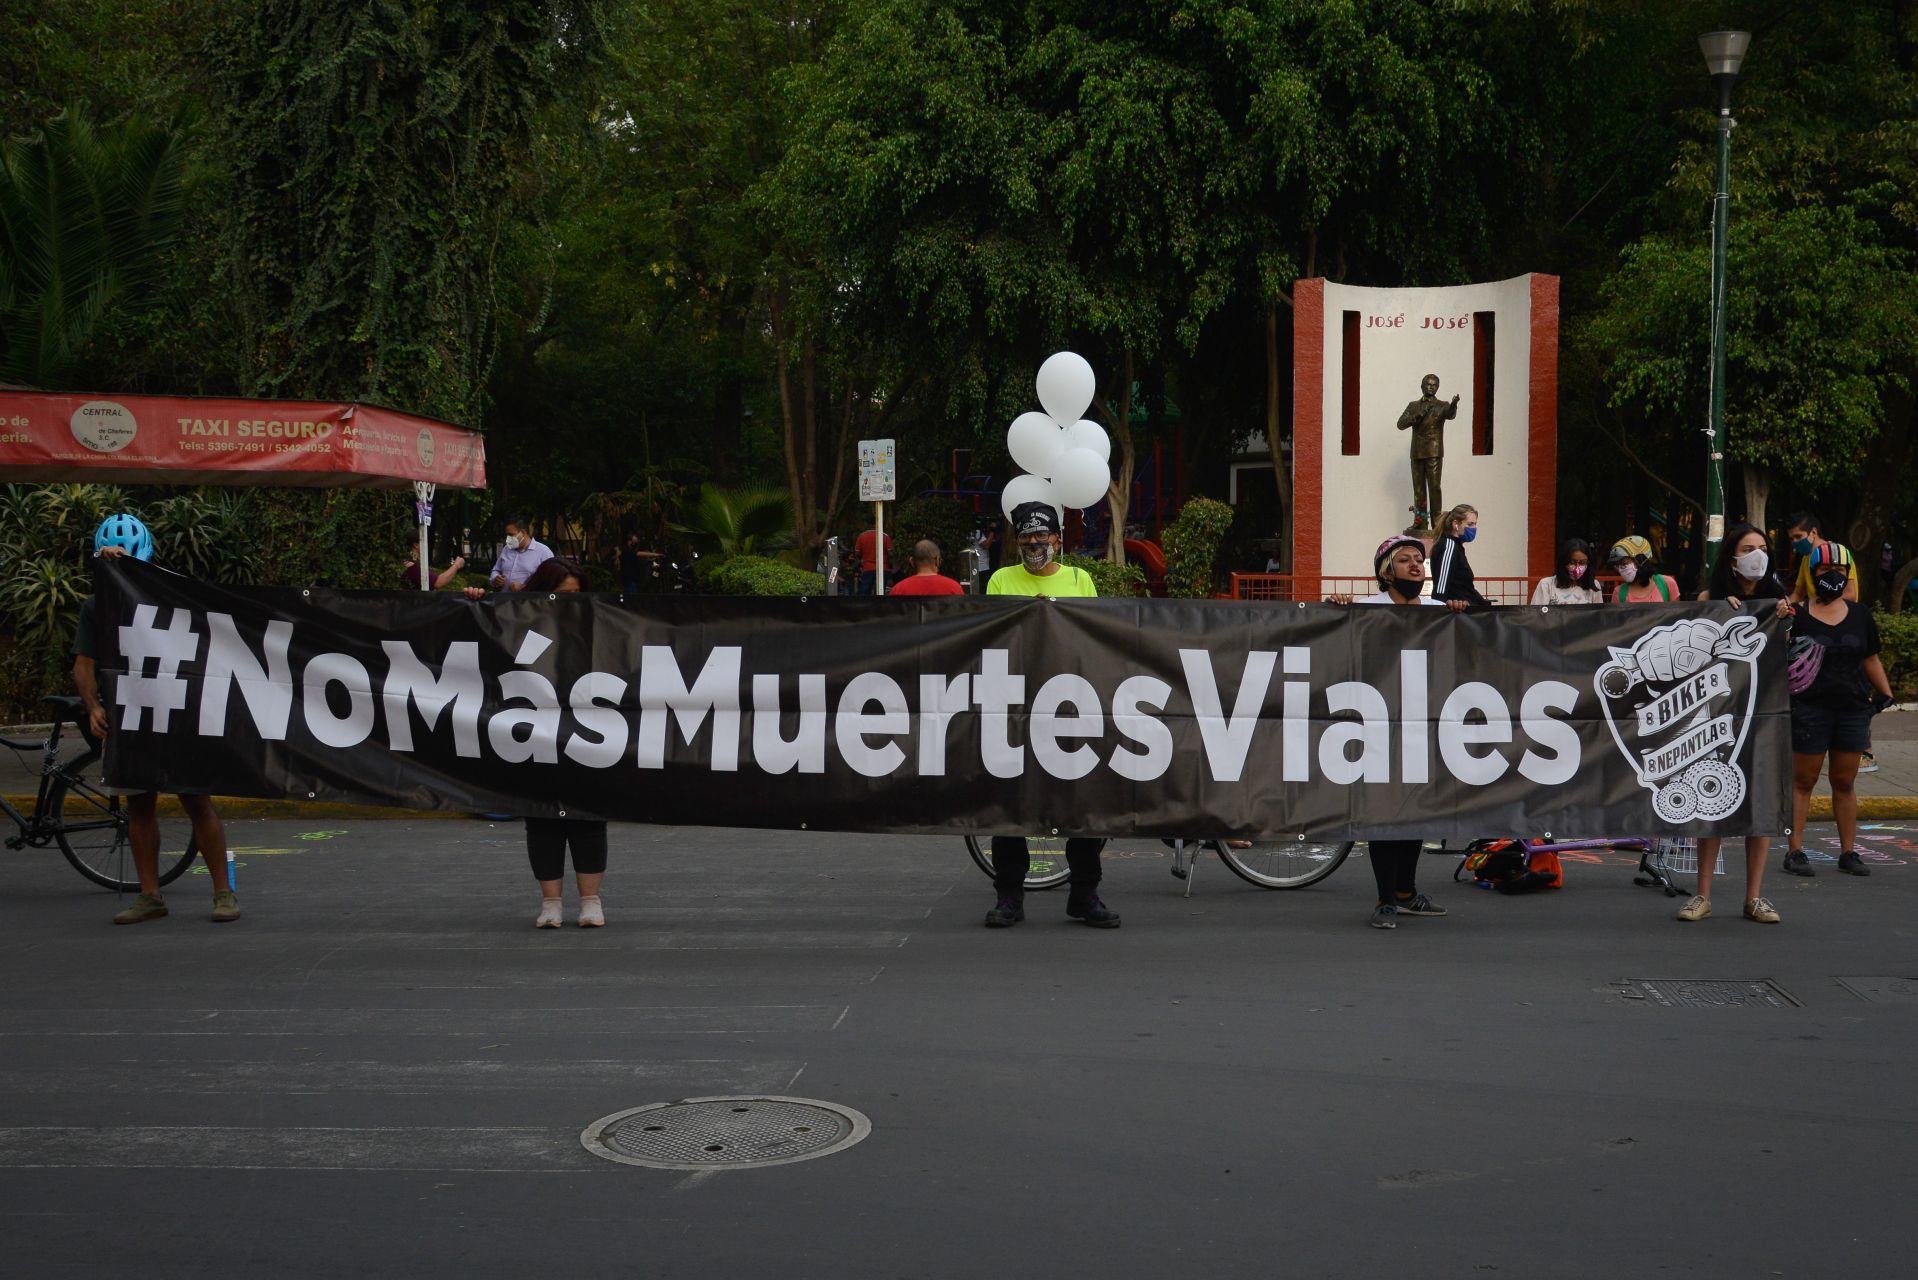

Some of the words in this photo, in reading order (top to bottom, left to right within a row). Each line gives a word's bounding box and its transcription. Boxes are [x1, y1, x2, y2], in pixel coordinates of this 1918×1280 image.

[83, 408, 123, 416] CENTRAL
[11, 415, 30, 426] de
[178, 419, 229, 436] TAXI
[237, 420, 333, 438] SEGURO
[179, 441, 204, 450] Tels:
[208, 442, 265, 452] 5396-7491
[1819, 579, 1845, 591] PNY
[116, 603, 1582, 786] #NoMásMuertesViales
[1657, 674, 1707, 725] BIKE
[1657, 723, 1719, 773] NEPANTLA
